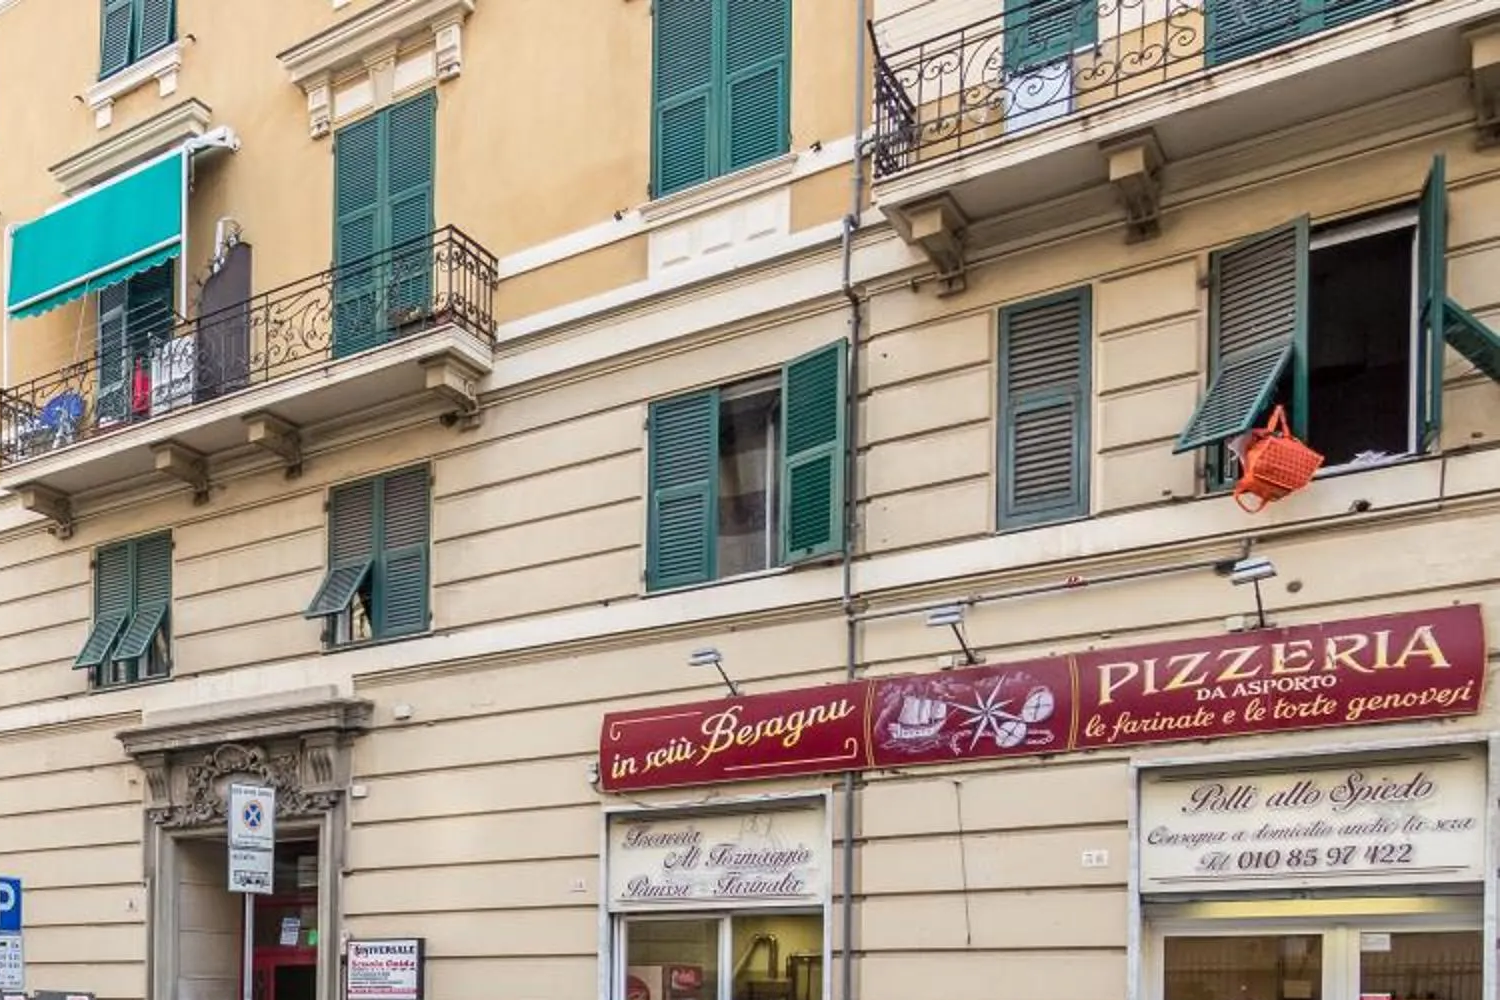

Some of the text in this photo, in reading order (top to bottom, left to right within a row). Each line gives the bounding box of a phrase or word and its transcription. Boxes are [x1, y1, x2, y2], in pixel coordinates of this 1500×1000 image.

[1096, 624, 1452, 707] PIZZERIA
[1196, 674, 1337, 701] DA ASPORTO
[1085, 679, 1474, 743] le farinate e le torte genovesi
[611, 753, 636, 779] in
[1182, 770, 1434, 813] Polli allo Spiedo
[1237, 849, 1281, 870] 010
[1286, 848, 1318, 868] 85
[1326, 845, 1356, 867] 97
[1364, 843, 1414, 865] 422
